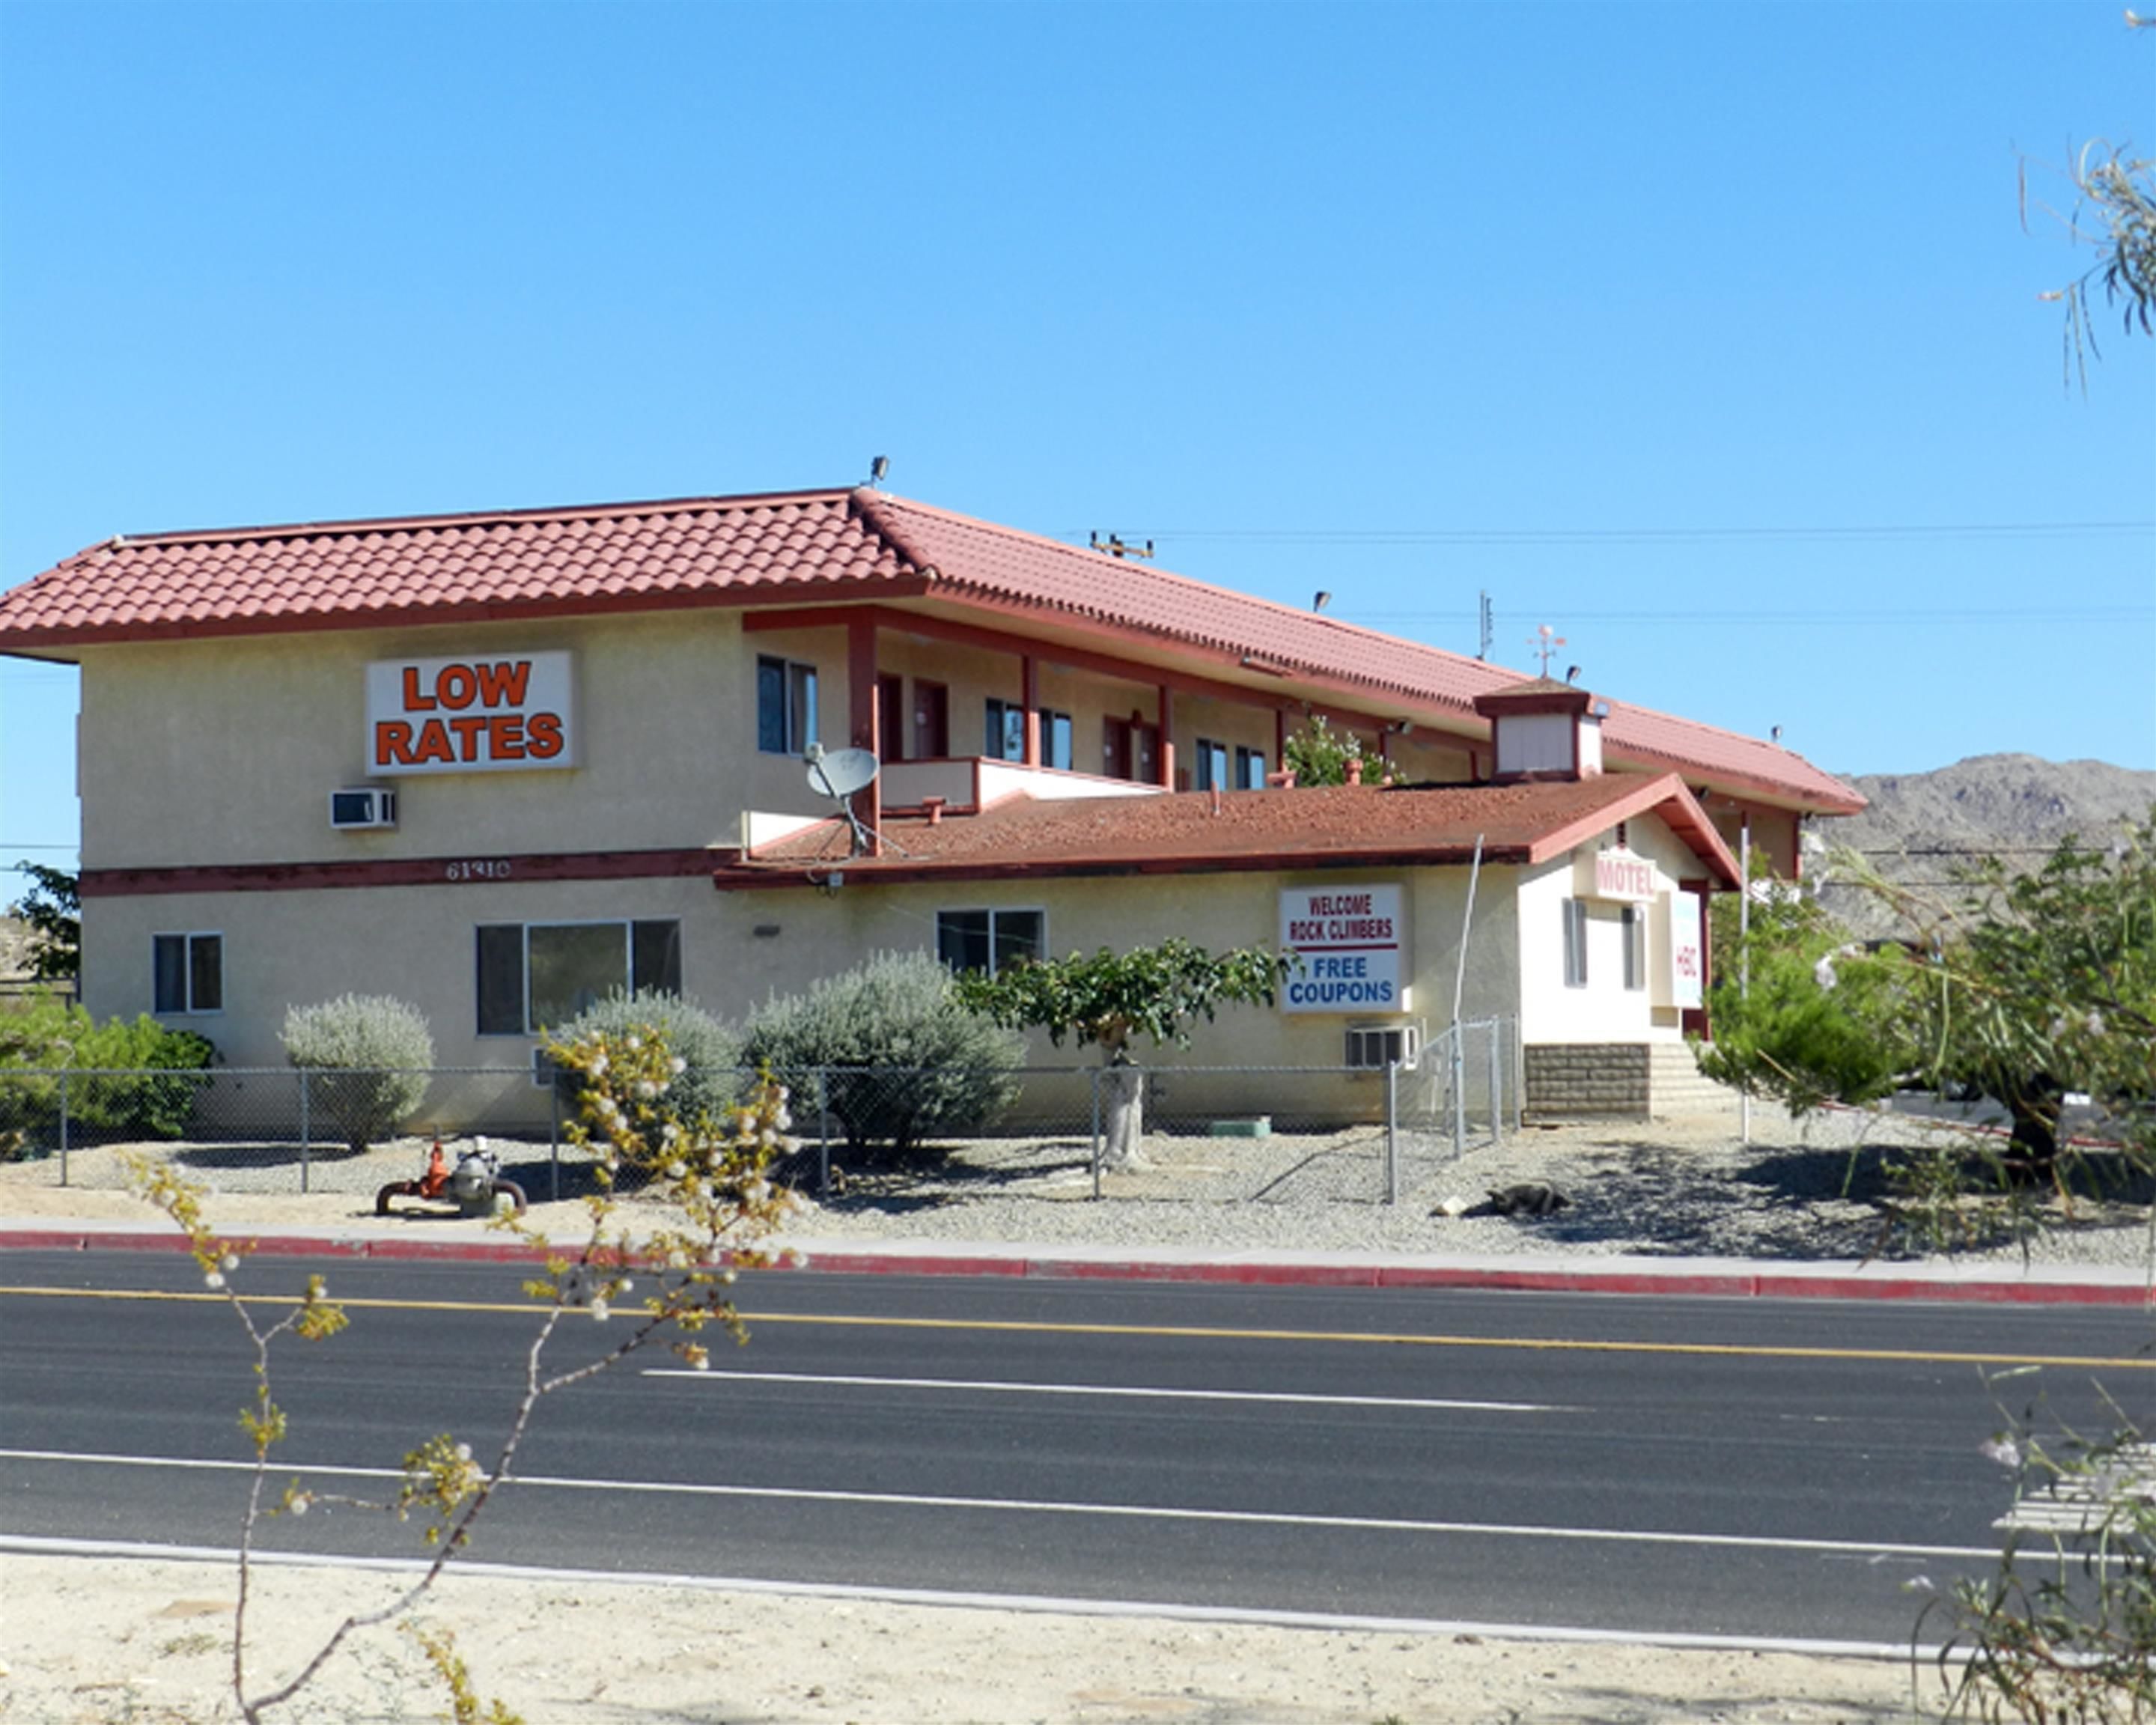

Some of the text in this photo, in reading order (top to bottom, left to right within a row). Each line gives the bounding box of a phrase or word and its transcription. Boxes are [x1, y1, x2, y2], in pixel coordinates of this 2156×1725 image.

[403, 661, 532, 711] LOW
[376, 713, 563, 764] RATES
[1597, 860, 1654, 897] MOTEL
[1309, 895, 1371, 916] WELCOME
[1290, 918, 1392, 940] ROCK CLIMBERS
[1314, 957, 1368, 979] FREE
[1290, 981, 1392, 1003] COUPONS
